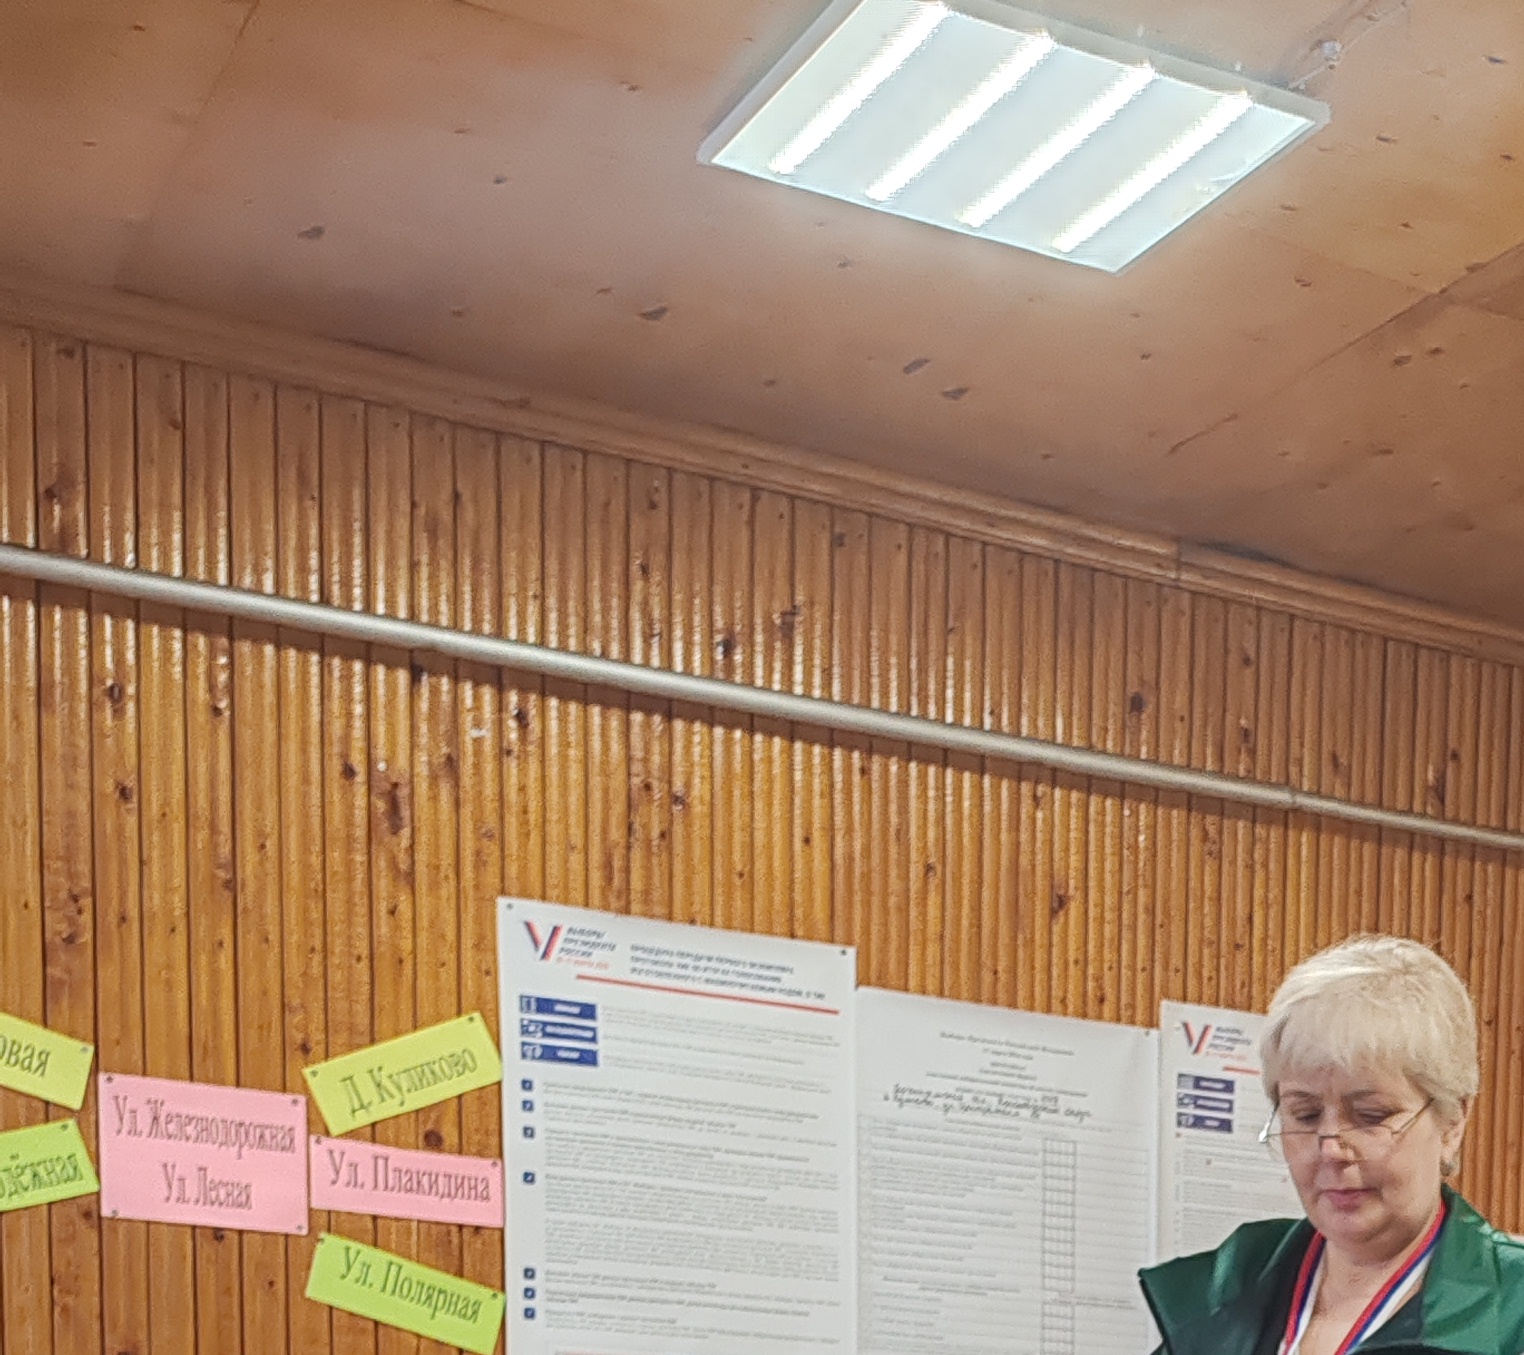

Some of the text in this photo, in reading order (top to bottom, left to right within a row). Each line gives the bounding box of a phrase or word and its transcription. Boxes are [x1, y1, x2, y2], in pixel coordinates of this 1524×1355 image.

[366, 1048, 478, 1107] Куликово
[113, 1095, 296, 1160] Ул. Железнодорожная
[161, 1162, 252, 1210] Ул. Лесная
[327, 1149, 491, 1203] Ул. Плакидина
[340, 1245, 482, 1325] Ул. Полярная
